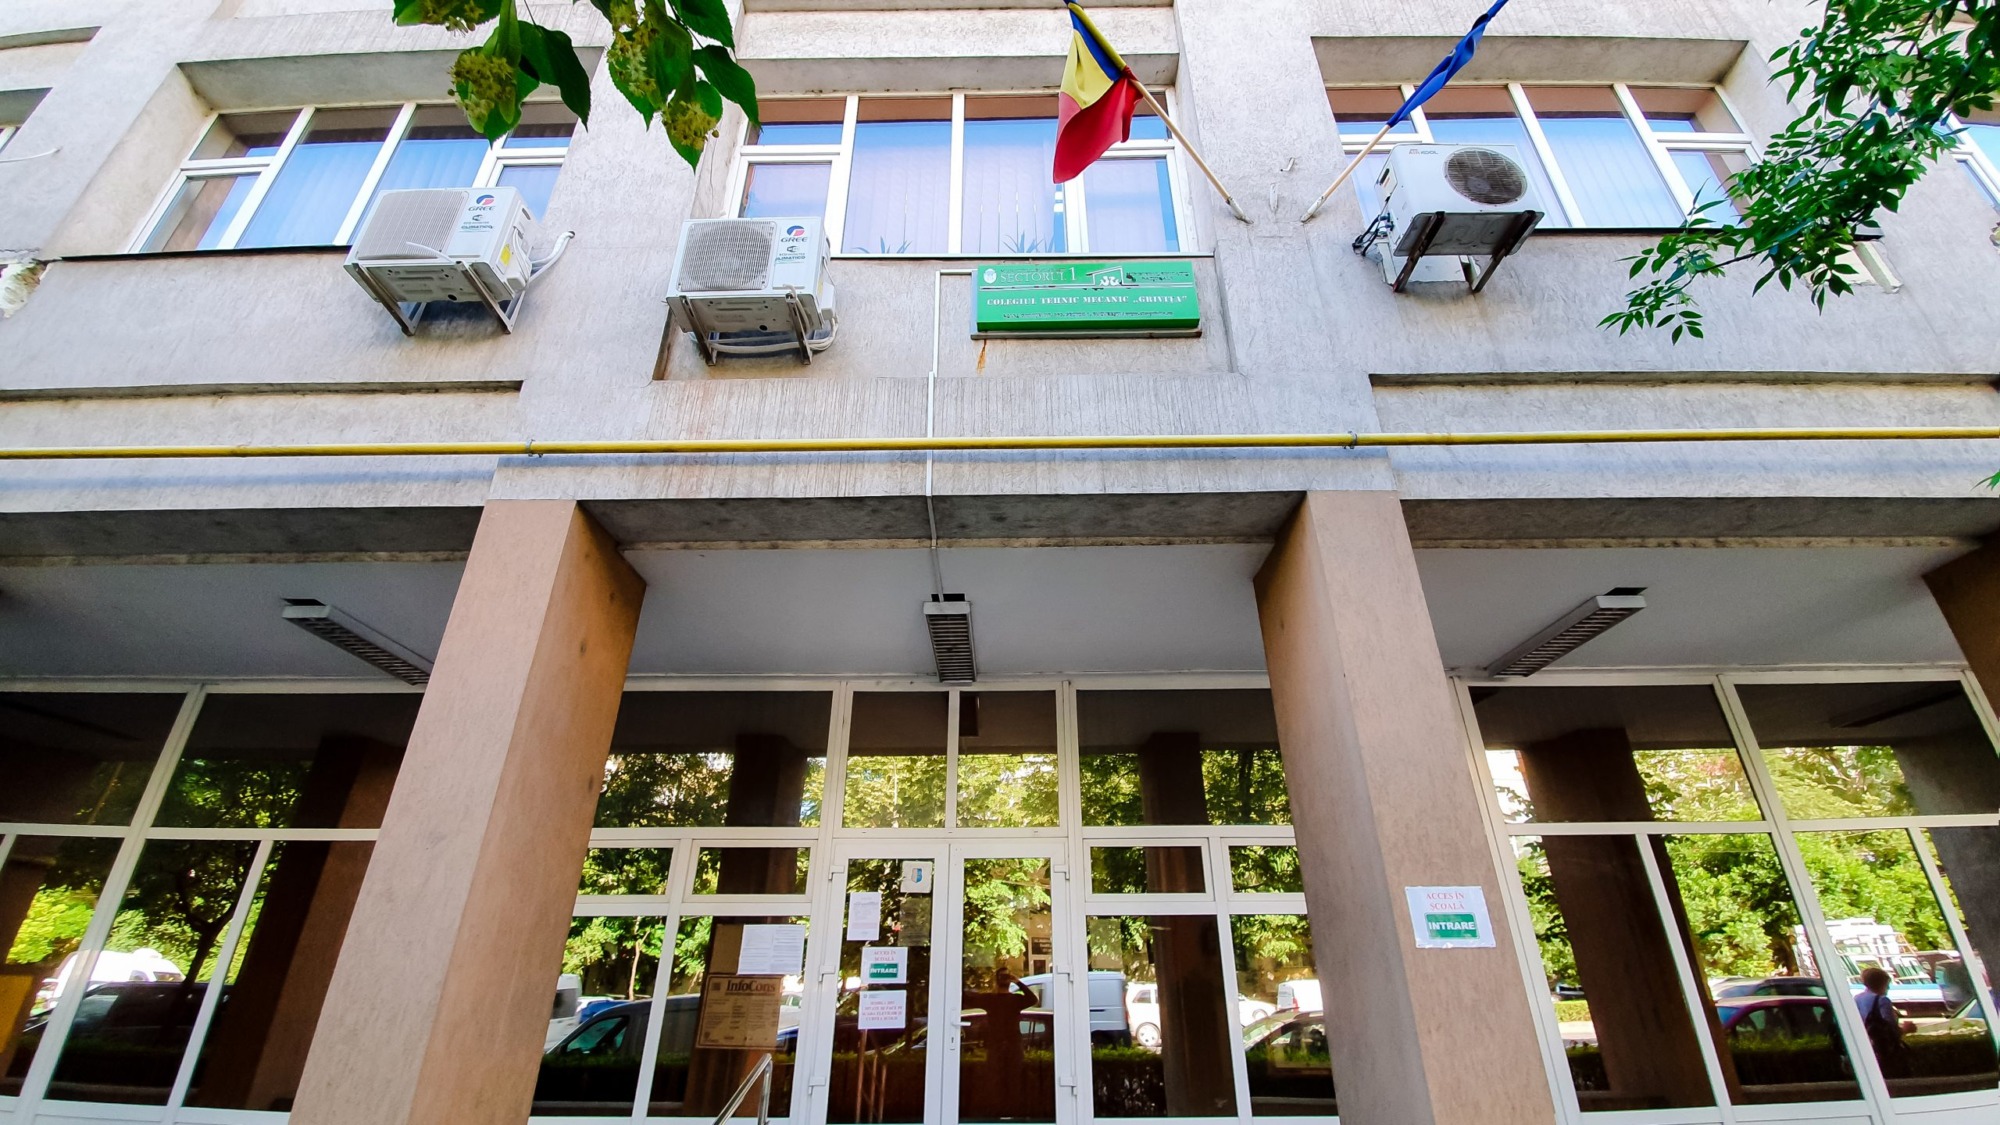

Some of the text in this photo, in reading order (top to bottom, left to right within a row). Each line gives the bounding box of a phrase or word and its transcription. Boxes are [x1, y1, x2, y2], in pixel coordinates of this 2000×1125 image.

[1000, 271, 1066, 282] SECTORUL
[1070, 266, 1077, 281] 1
[987, 297, 1037, 306] COLEGIUL
[1041, 296, 1080, 304] TEHNIC
[1430, 902, 1465, 910] ȘCOALĂ
[1428, 922, 1476, 930] INTRARE
[726, 980, 776, 992] InfoCons
